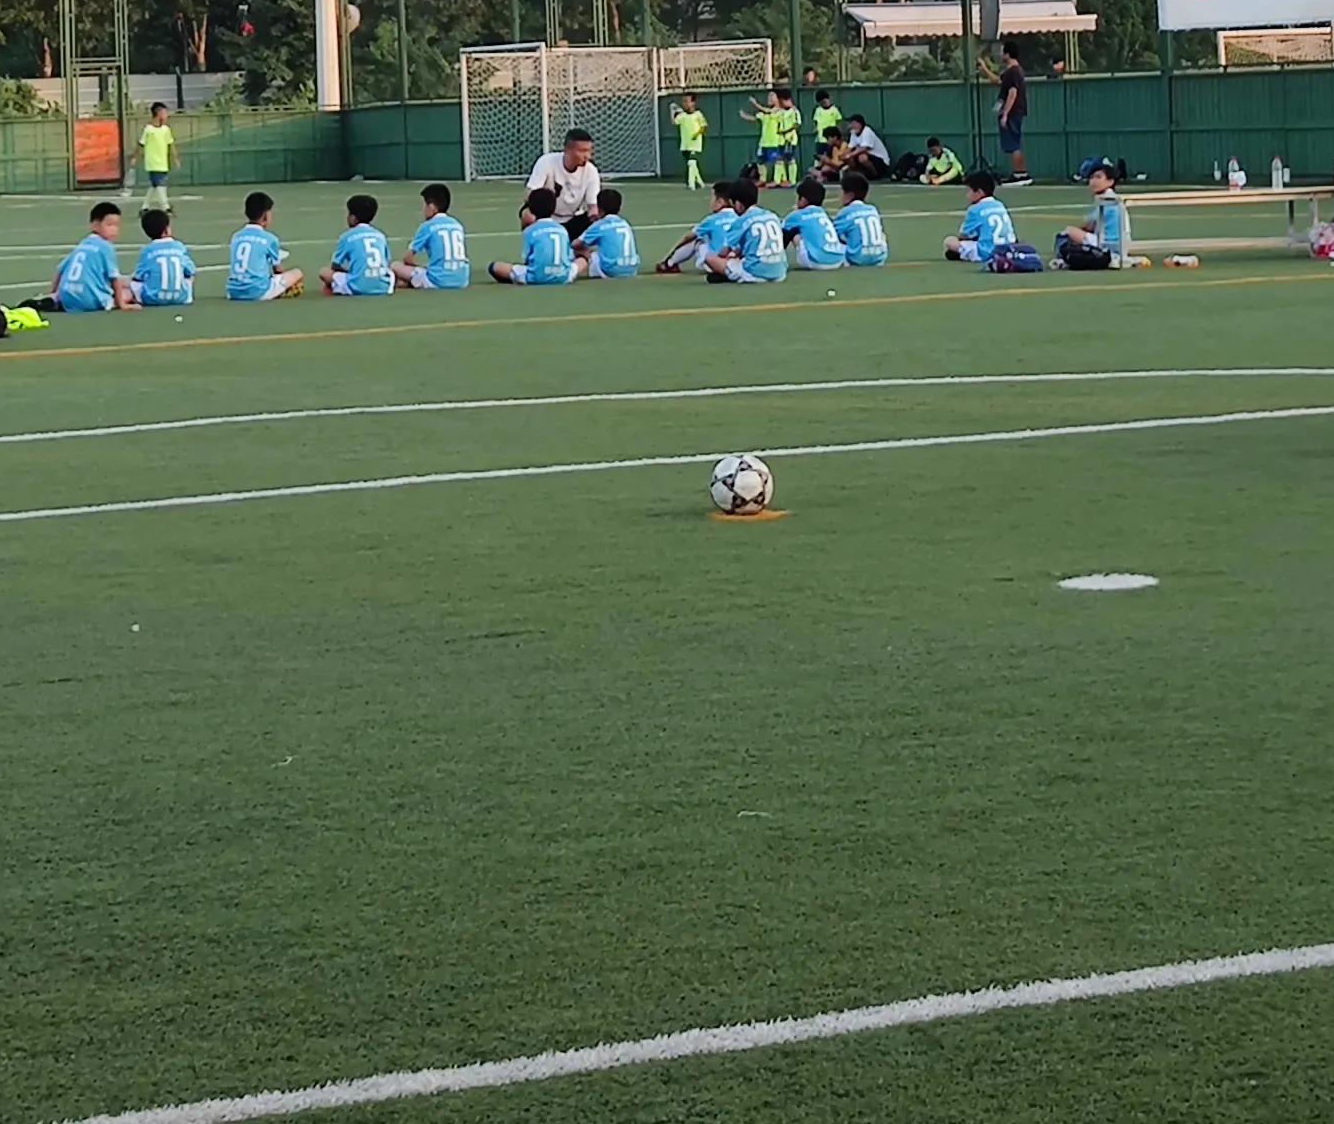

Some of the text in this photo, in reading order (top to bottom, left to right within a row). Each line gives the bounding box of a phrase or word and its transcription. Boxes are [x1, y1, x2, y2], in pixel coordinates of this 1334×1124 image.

[616, 227, 633, 257] 7
[751, 220, 784, 257] 29
[854, 215, 882, 246] 10
[234, 242, 252, 274] 9
[363, 238, 382, 269] 5
[550, 233, 562, 265] 1
[68, 251, 86, 282] 6
[156, 256, 182, 291] 11
